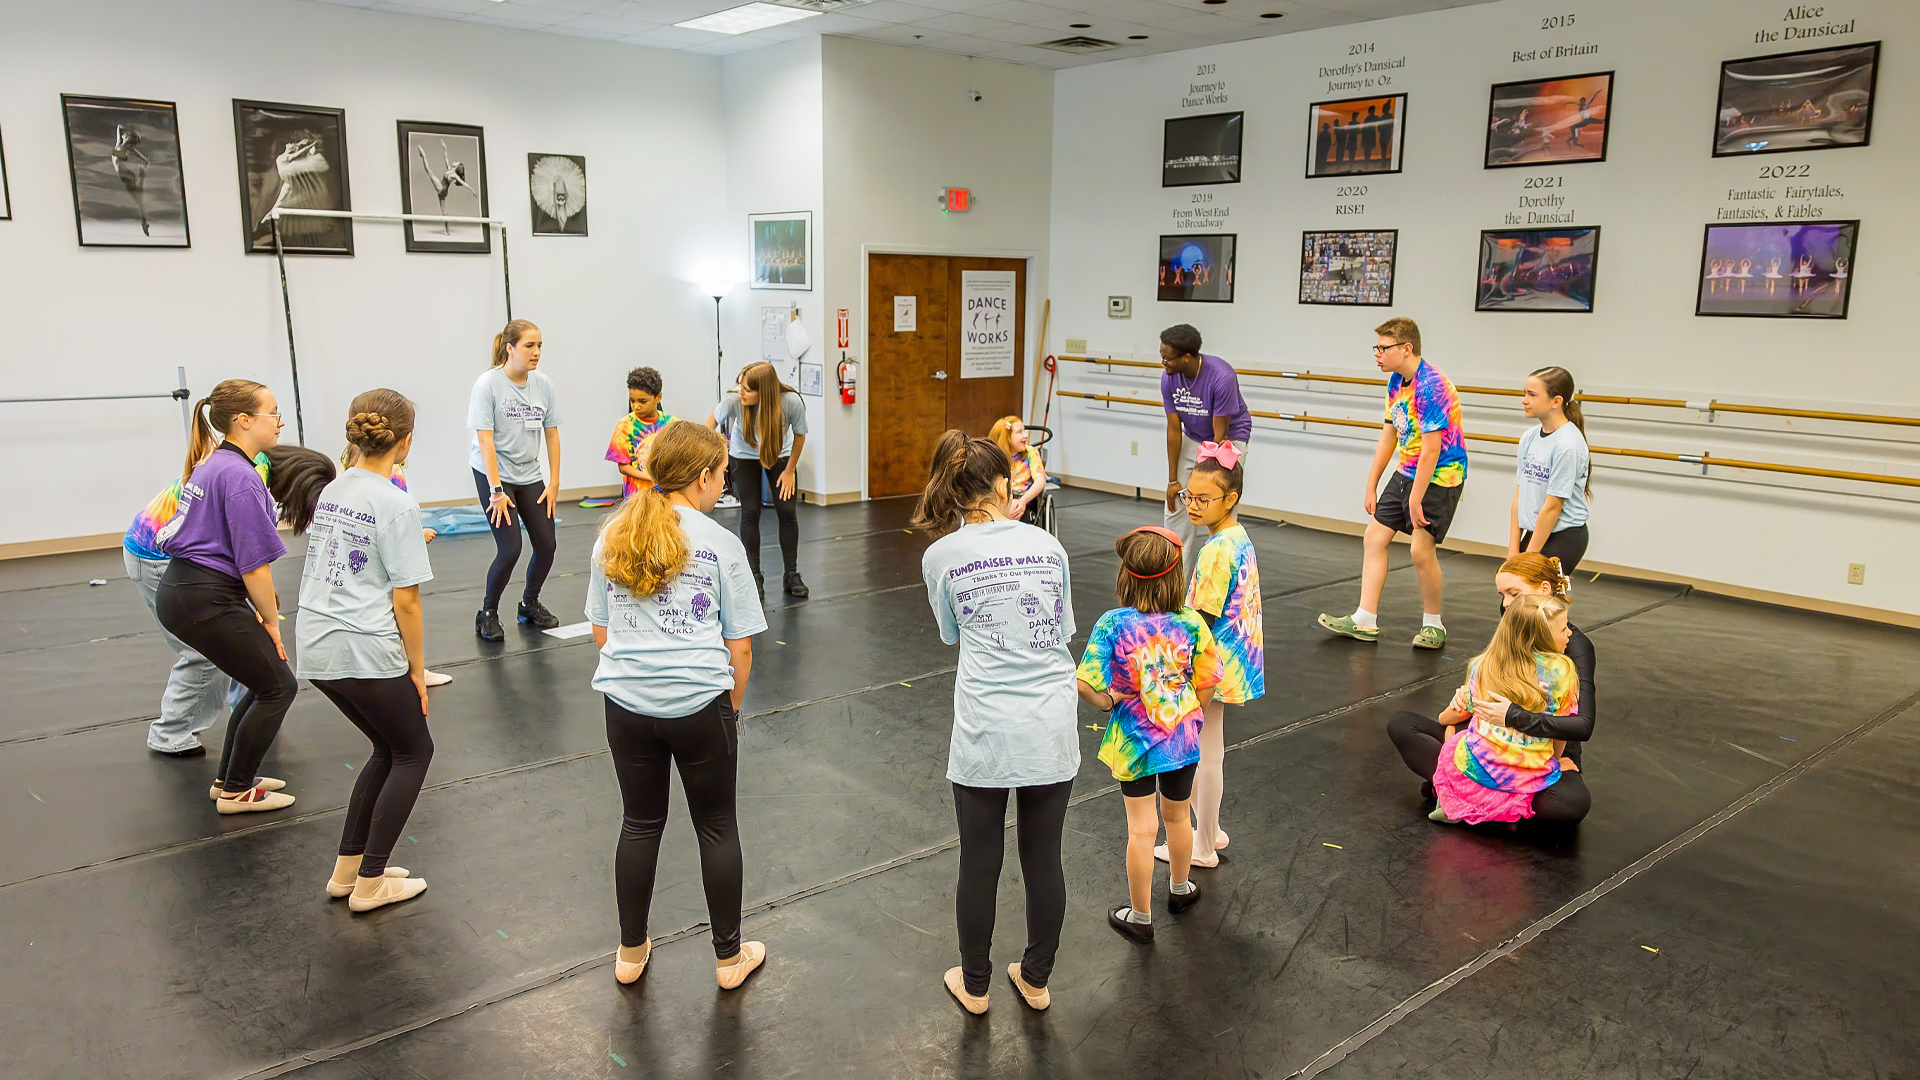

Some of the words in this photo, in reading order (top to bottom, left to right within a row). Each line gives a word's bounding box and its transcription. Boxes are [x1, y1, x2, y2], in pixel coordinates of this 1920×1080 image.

[1783, 5, 1824, 21] Alice
[1541, 13, 1576, 30] 2015
[1755, 29, 1779, 43] the
[1784, 18, 1855, 40] Dansical
[1348, 42, 1375, 56] 2014
[1512, 49, 1536, 63] Best
[1539, 46, 1554, 60] of
[1555, 41, 1598, 58] Britain
[1196, 63, 1216, 76] 2013
[1318, 62, 1362, 78] Dorothy's
[1364, 55, 1406, 73] Dansical
[1188, 81, 1217, 96] Journey
[1218, 80, 1226, 90] to
[1326, 79, 1363, 95] Journey
[1364, 77, 1374, 88] to
[1377, 74, 1392, 86] Oz
[1182, 97, 1204, 108] Dance
[1205, 92, 1229, 105] Works
[1758, 164, 1811, 179] 2022
[1523, 176, 1563, 189] 2021
[1191, 192, 1213, 204] 2019
[1336, 185, 1368, 197] 2020
[1727, 186, 1777, 201] Fantastic
[1785, 184, 1844, 201] Fairytales,
[948, 189, 968, 210] EXIT
[1519, 193, 1565, 209] Dorothy
[1172, 208, 1193, 218] From
[1194, 207, 1213, 217] West
[1213, 206, 1230, 217] End
[1336, 204, 1365, 215] RISE!
[1504, 211, 1522, 225] the
[1527, 209, 1575, 224] Dansical
[1716, 205, 1769, 220] Fantasies,
[1774, 204, 1784, 218] &
[1787, 203, 1824, 218] Fables
[1176, 219, 1184, 229] to
[1185, 217, 1225, 229] Broadway
[968, 297, 1007, 311] DANCE
[967, 329, 1008, 344] WORKS
[694, 549, 718, 563] 2025
[949, 556, 1013, 579] FUNDRAISER
[1015, 555, 1044, 566] WALK
[971, 573, 998, 584] Thanks
[658, 608, 689, 619] DANCE
[1029, 618, 1055, 629] DANC
[1030, 637, 1060, 649] WORKS
